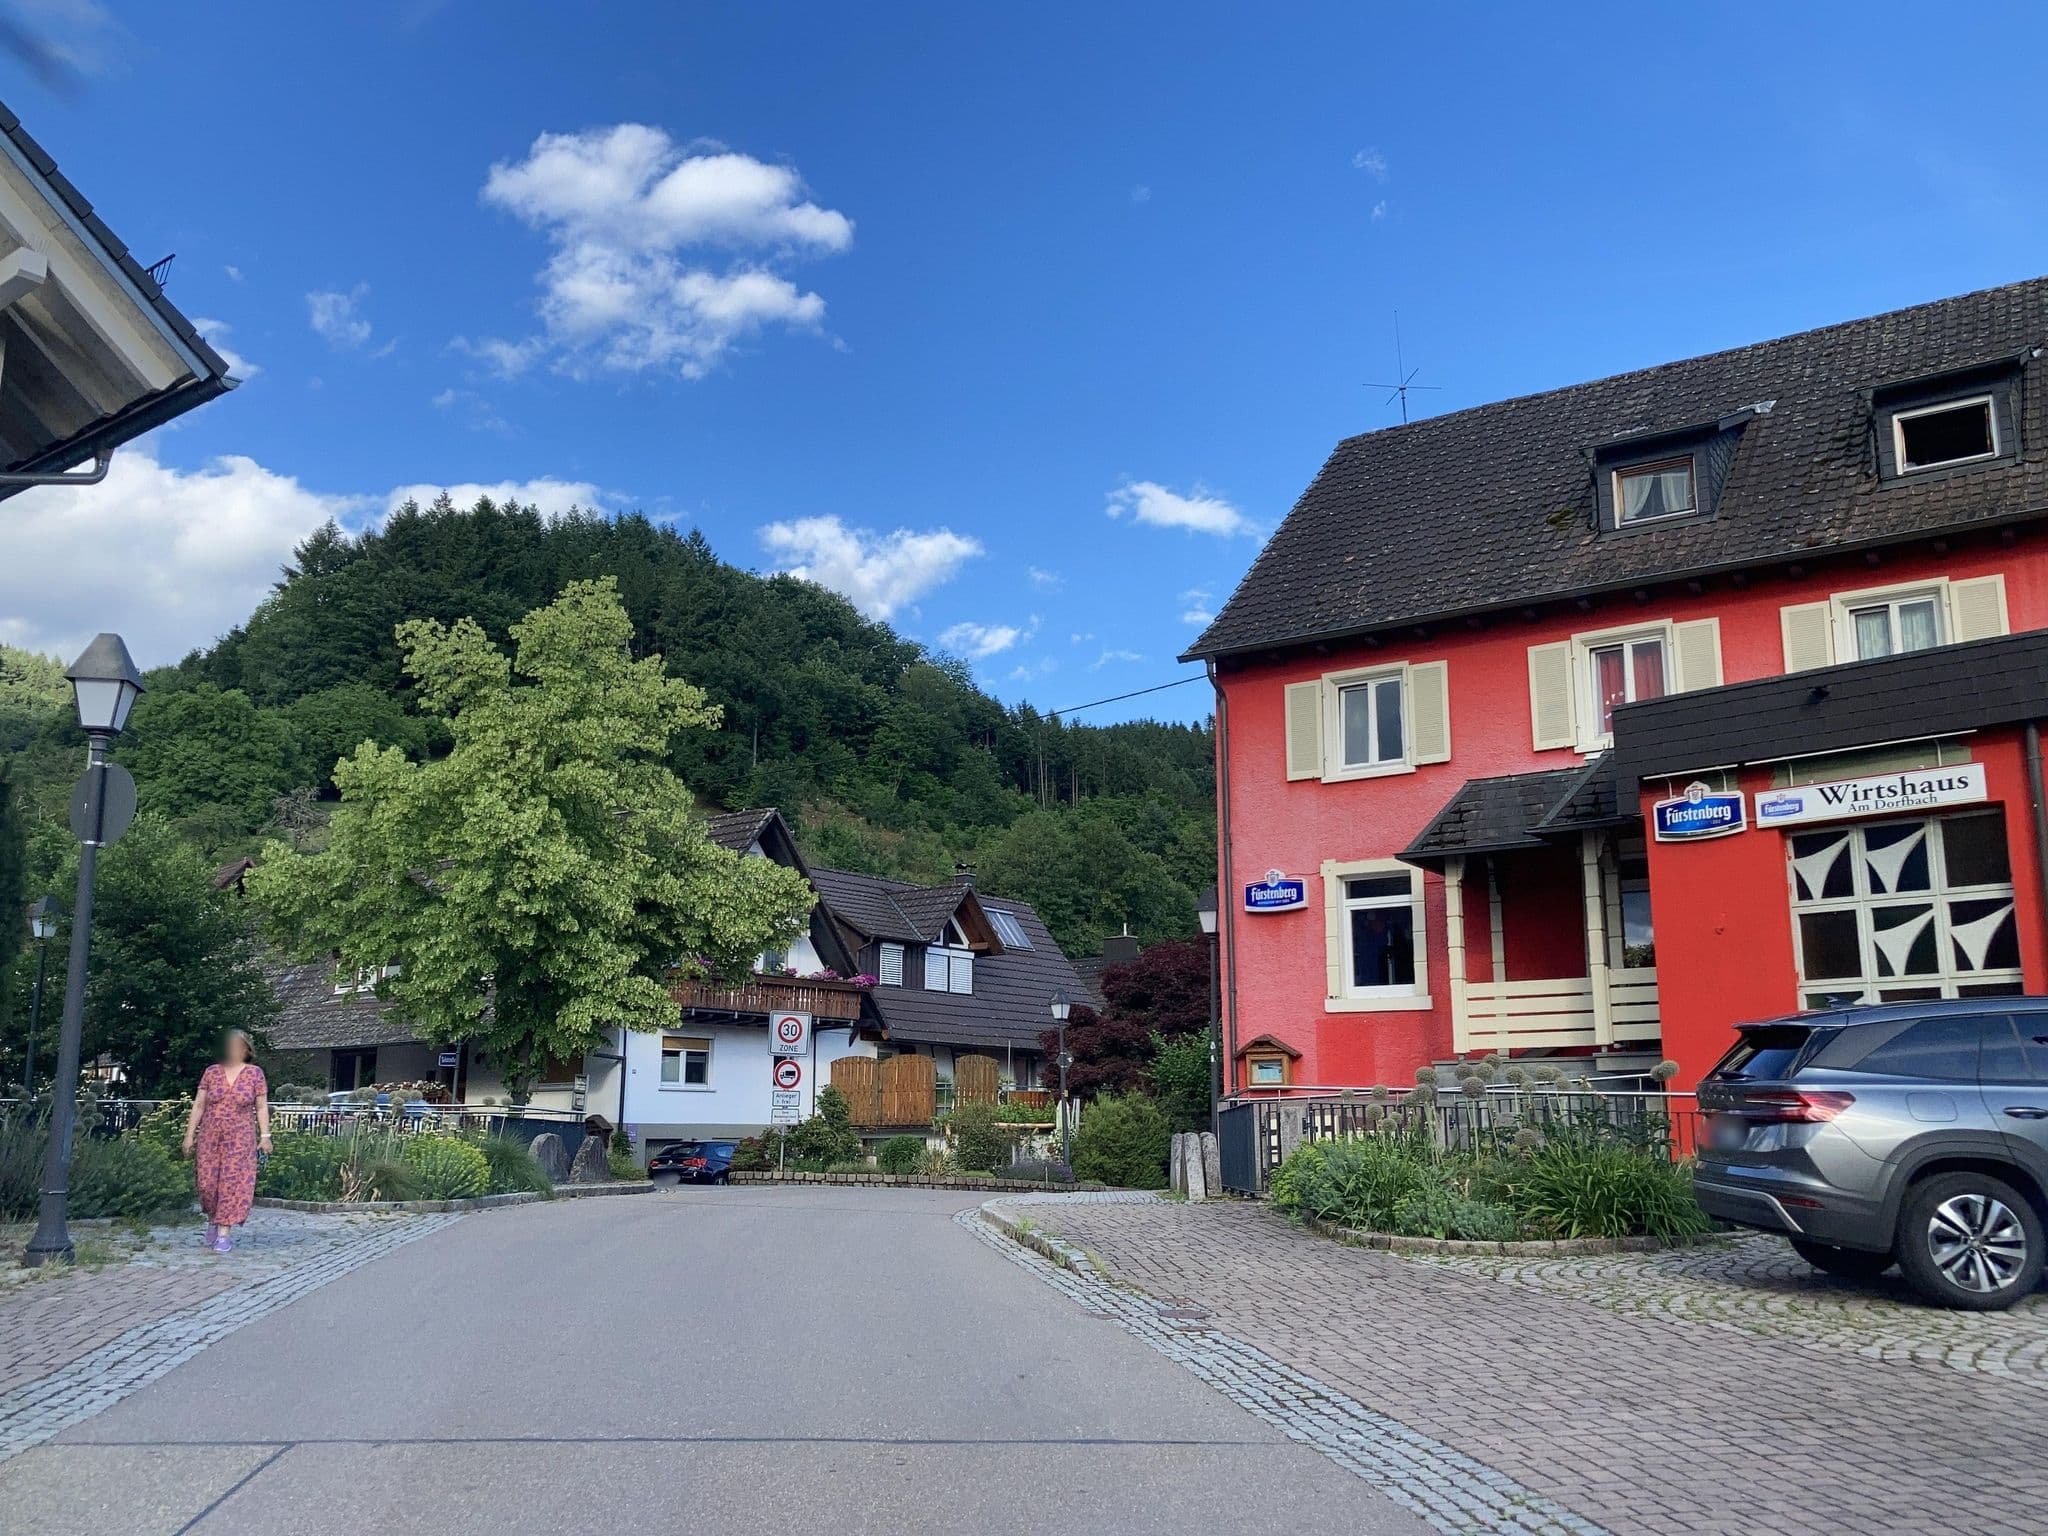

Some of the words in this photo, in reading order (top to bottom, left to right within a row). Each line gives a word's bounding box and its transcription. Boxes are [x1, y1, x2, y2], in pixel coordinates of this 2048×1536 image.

[1817, 775, 1969, 806] Wirtshaus
[1847, 803, 1870, 813] Am
[1875, 793, 1938, 810] Dorfbach
[783, 1024, 798, 1037] 30
